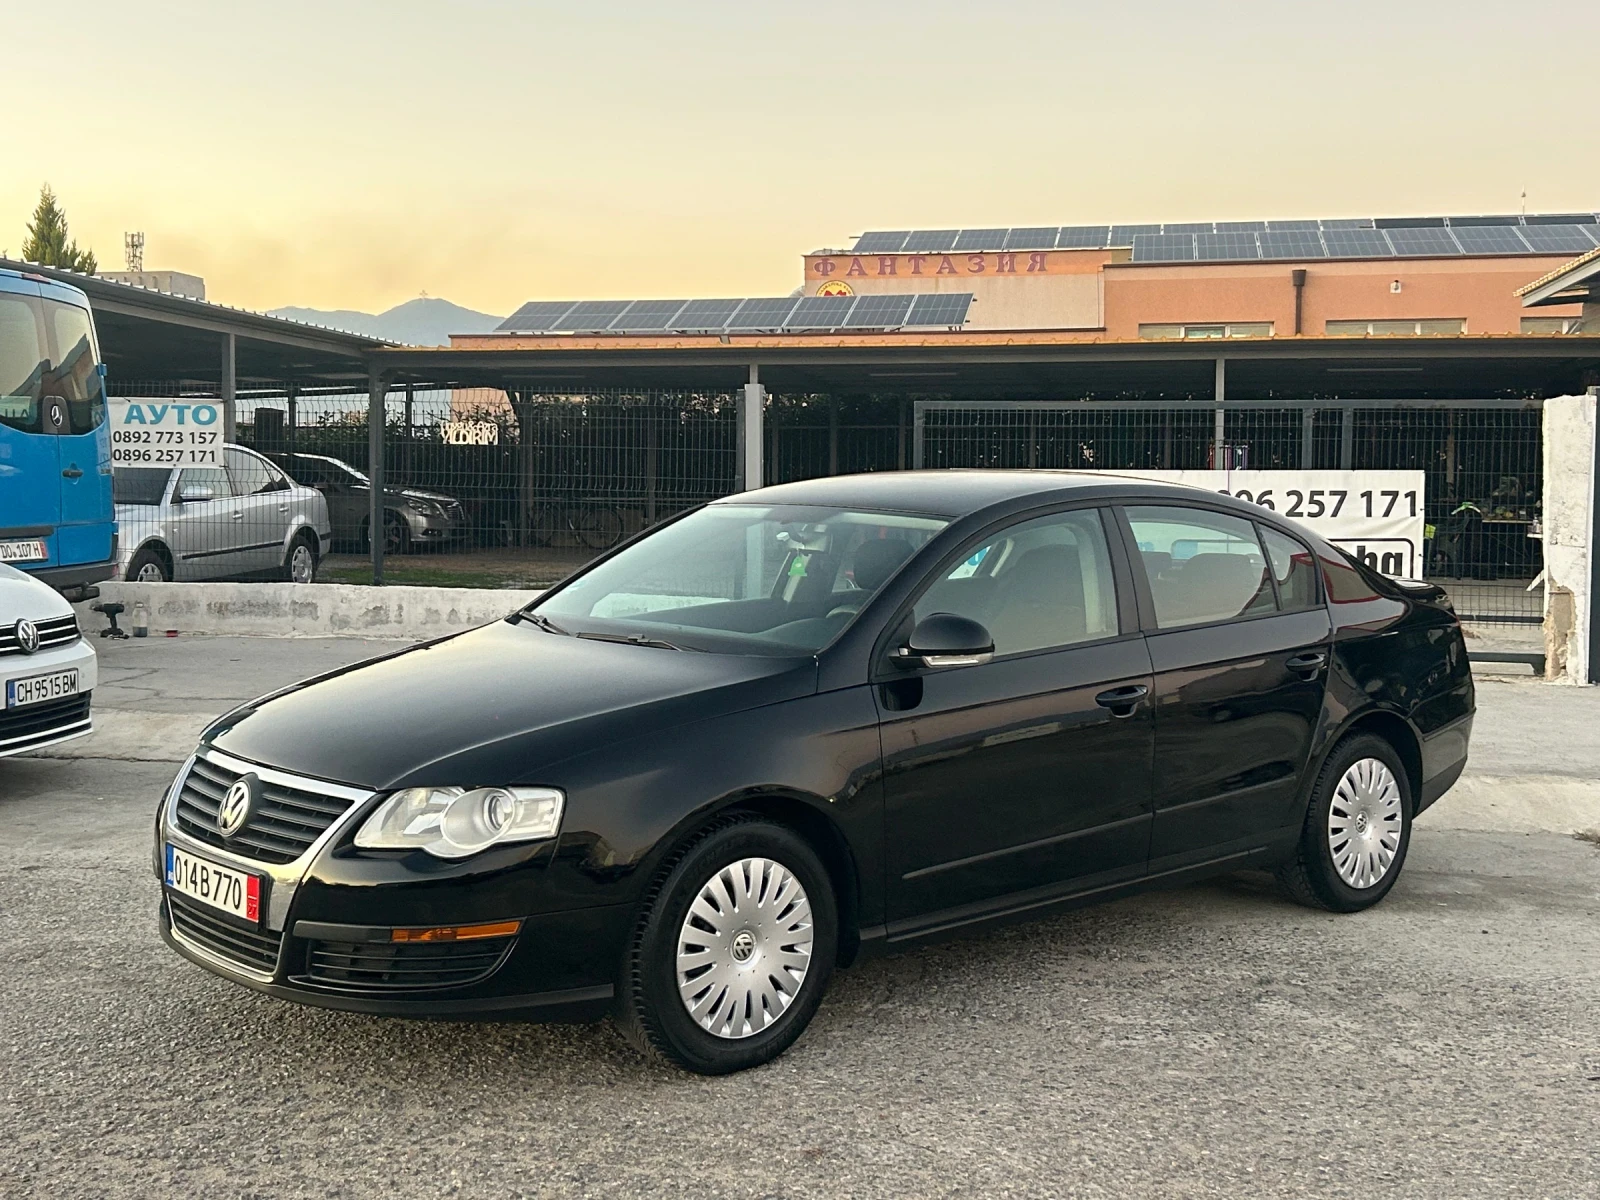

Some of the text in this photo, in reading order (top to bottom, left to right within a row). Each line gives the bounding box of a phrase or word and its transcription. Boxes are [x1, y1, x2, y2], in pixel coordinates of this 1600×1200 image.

[813, 252, 1048, 277] ФАНТАЗИЯ
[123, 404, 218, 426] АУТО
[112, 430, 218, 445] 0892 773 157
[112, 448, 216, 463] 0896 257 171
[1285, 490, 1348, 518] 257
[1360, 490, 1417, 518] 171
[175, 854, 242, 911] 014B770
